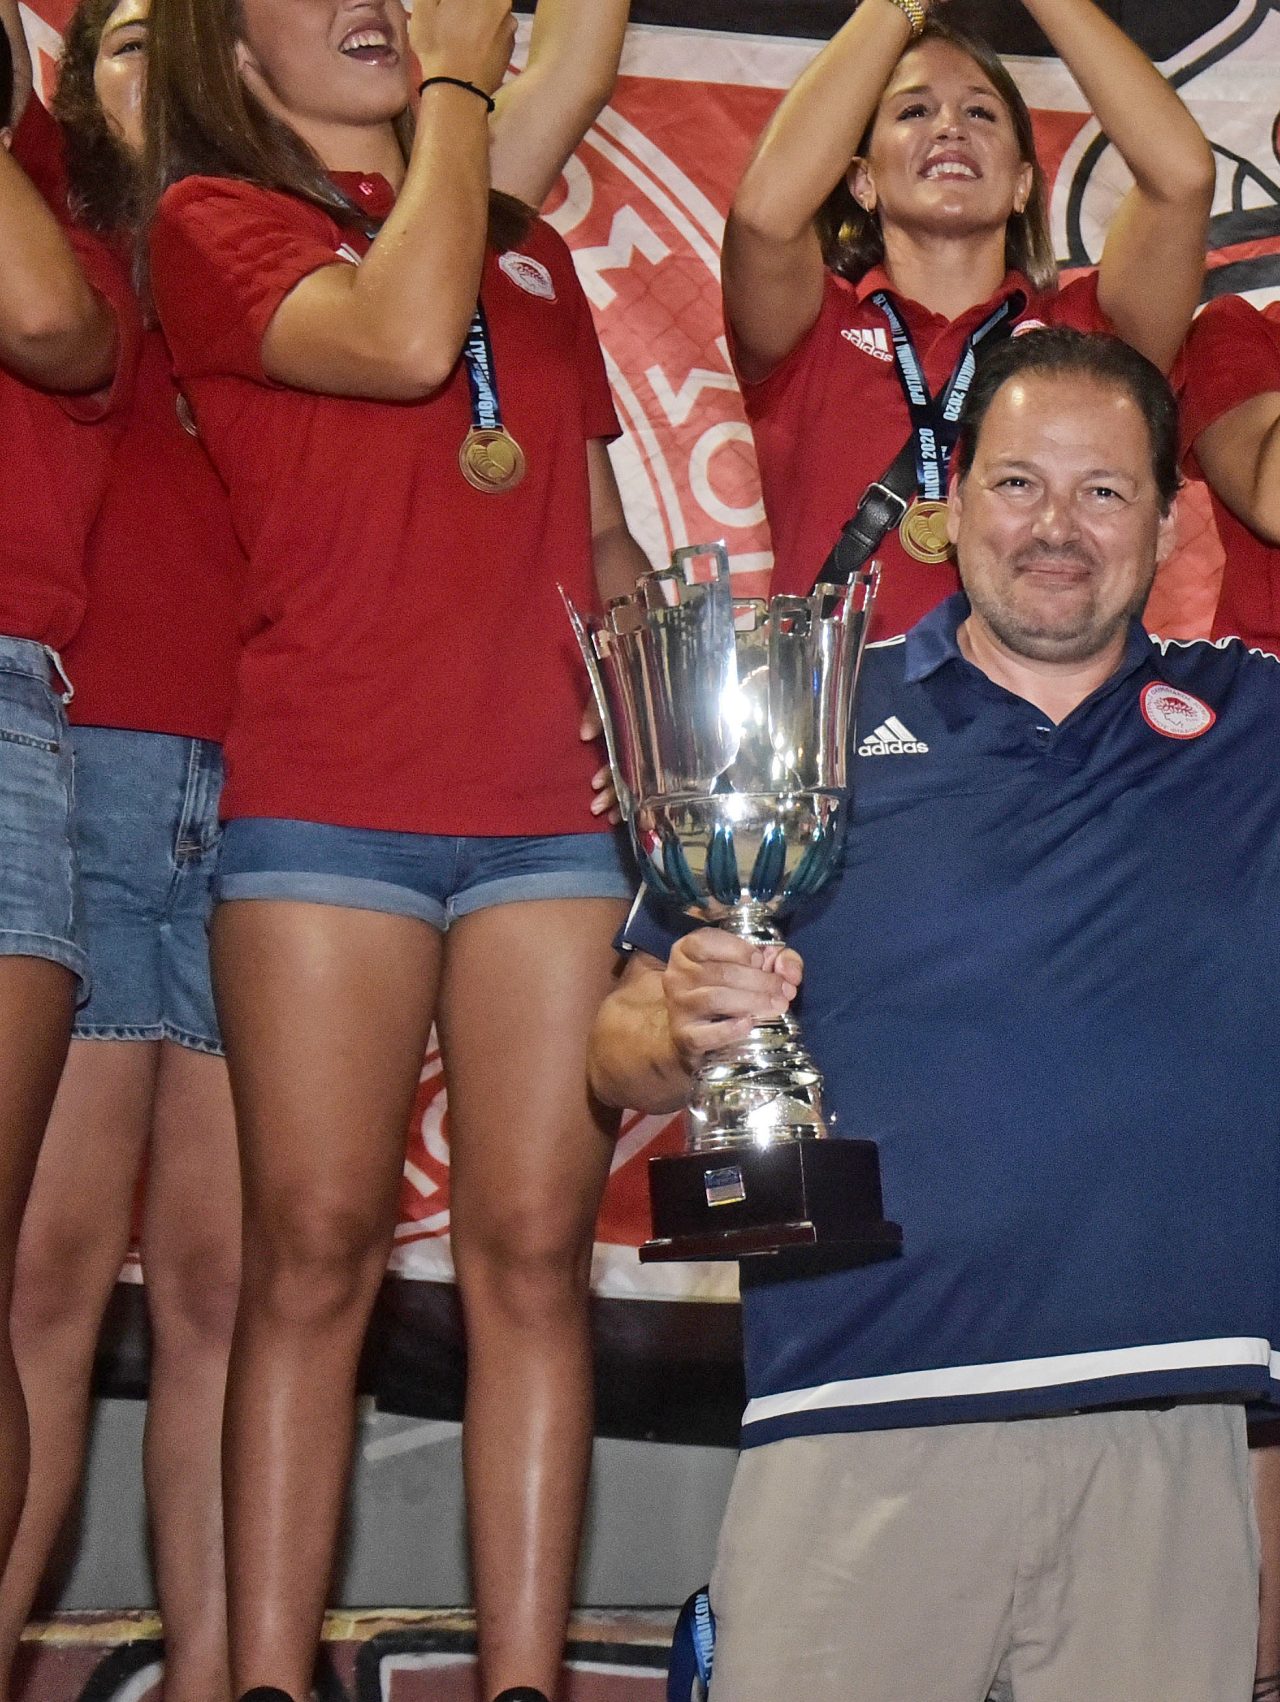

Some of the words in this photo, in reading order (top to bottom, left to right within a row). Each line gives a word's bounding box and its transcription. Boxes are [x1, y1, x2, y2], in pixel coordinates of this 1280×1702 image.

[841, 329, 894, 363] adidas
[943, 389, 966, 422] 2020
[919, 427, 937, 460] 2020
[923, 461, 940, 500] ΑΙΚΩΝ
[858, 739, 929, 757] adidas
